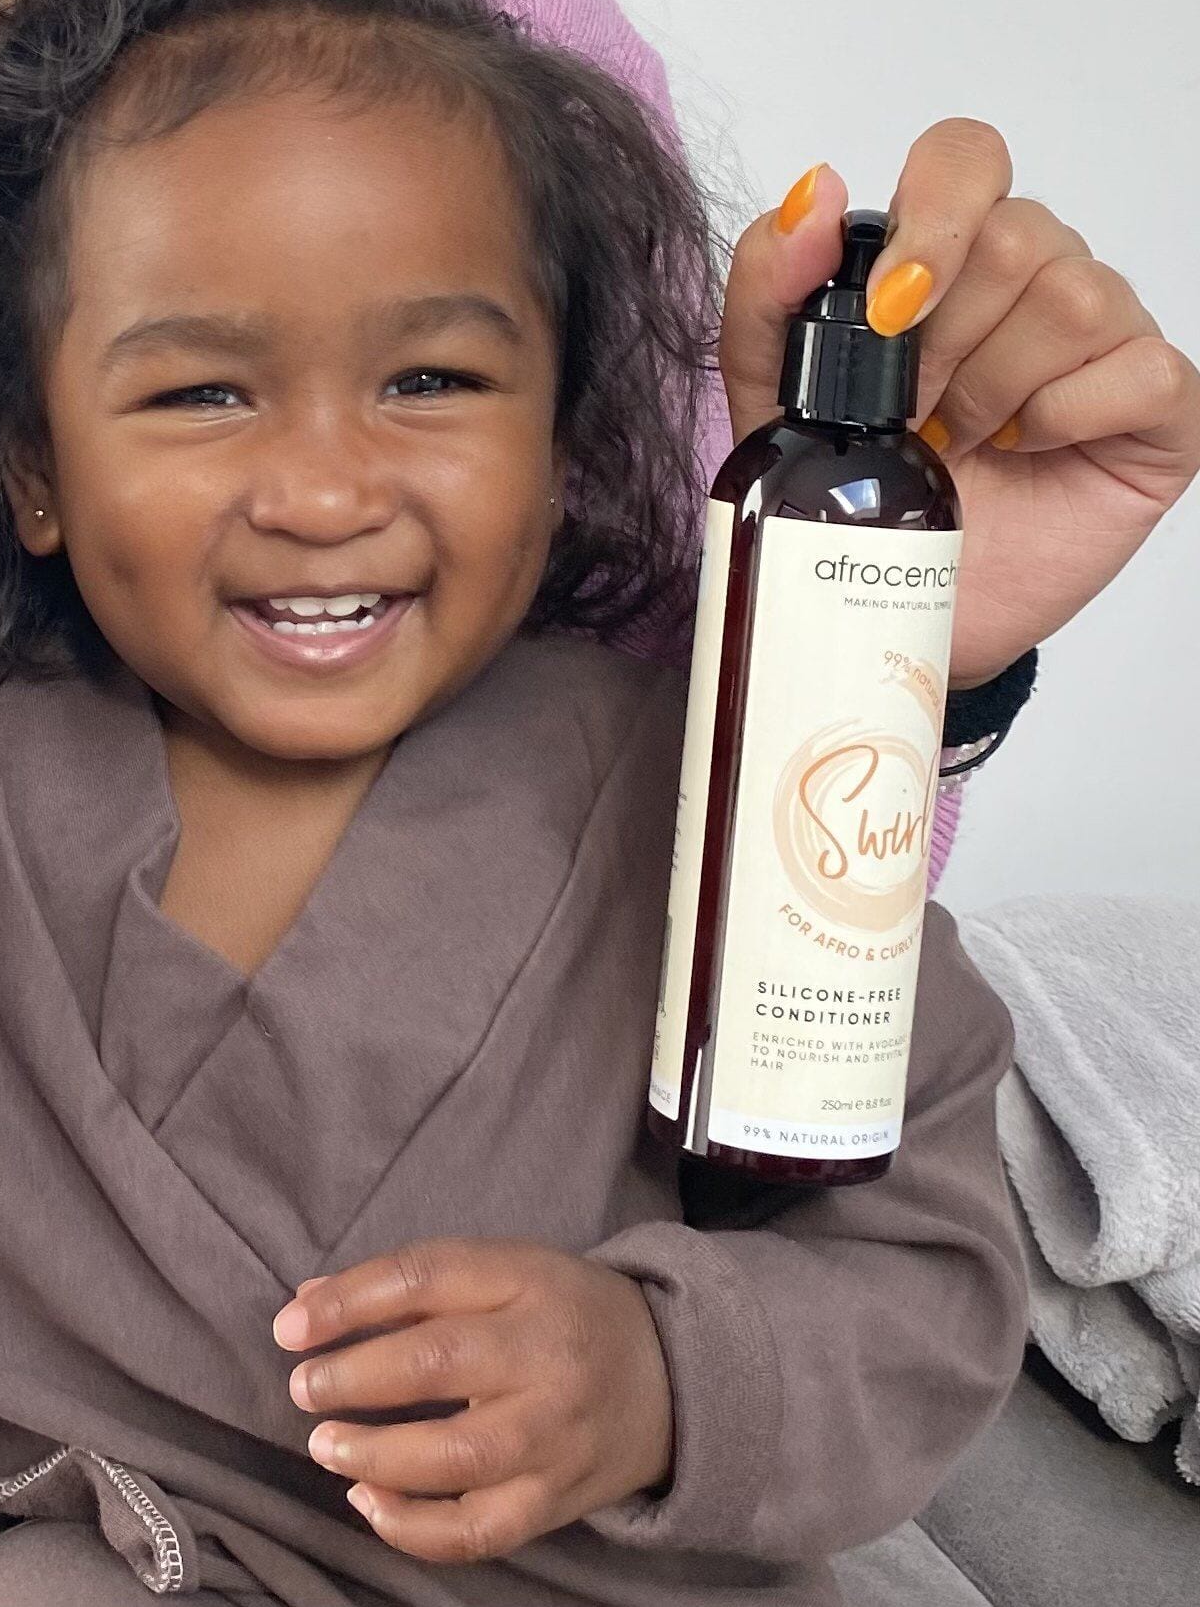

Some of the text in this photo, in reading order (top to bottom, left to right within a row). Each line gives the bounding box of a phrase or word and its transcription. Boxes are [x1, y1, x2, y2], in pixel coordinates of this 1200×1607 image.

[815, 554, 959, 588] afrocench
[844, 596, 890, 610] MAKING
[892, 600, 932, 612] NATURAL
[883, 649, 913, 674] 99%
[778, 902, 914, 962] FOR AFRO & CURLY
[756, 980, 903, 1004] SILICONE-FREE
[755, 1004, 892, 1026] CONDITIONER
[752, 1030, 826, 1051] ENRICHED
[831, 1040, 864, 1052] WITH
[750, 1058, 785, 1072] HAIR
[751, 1044, 771, 1057] TO
[776, 1046, 840, 1064] NOURISH
[846, 1053, 870, 1064] AND
[820, 1098, 854, 1112] 250ml
[743, 1124, 890, 1147] 99% NATURAL ORIGIN
